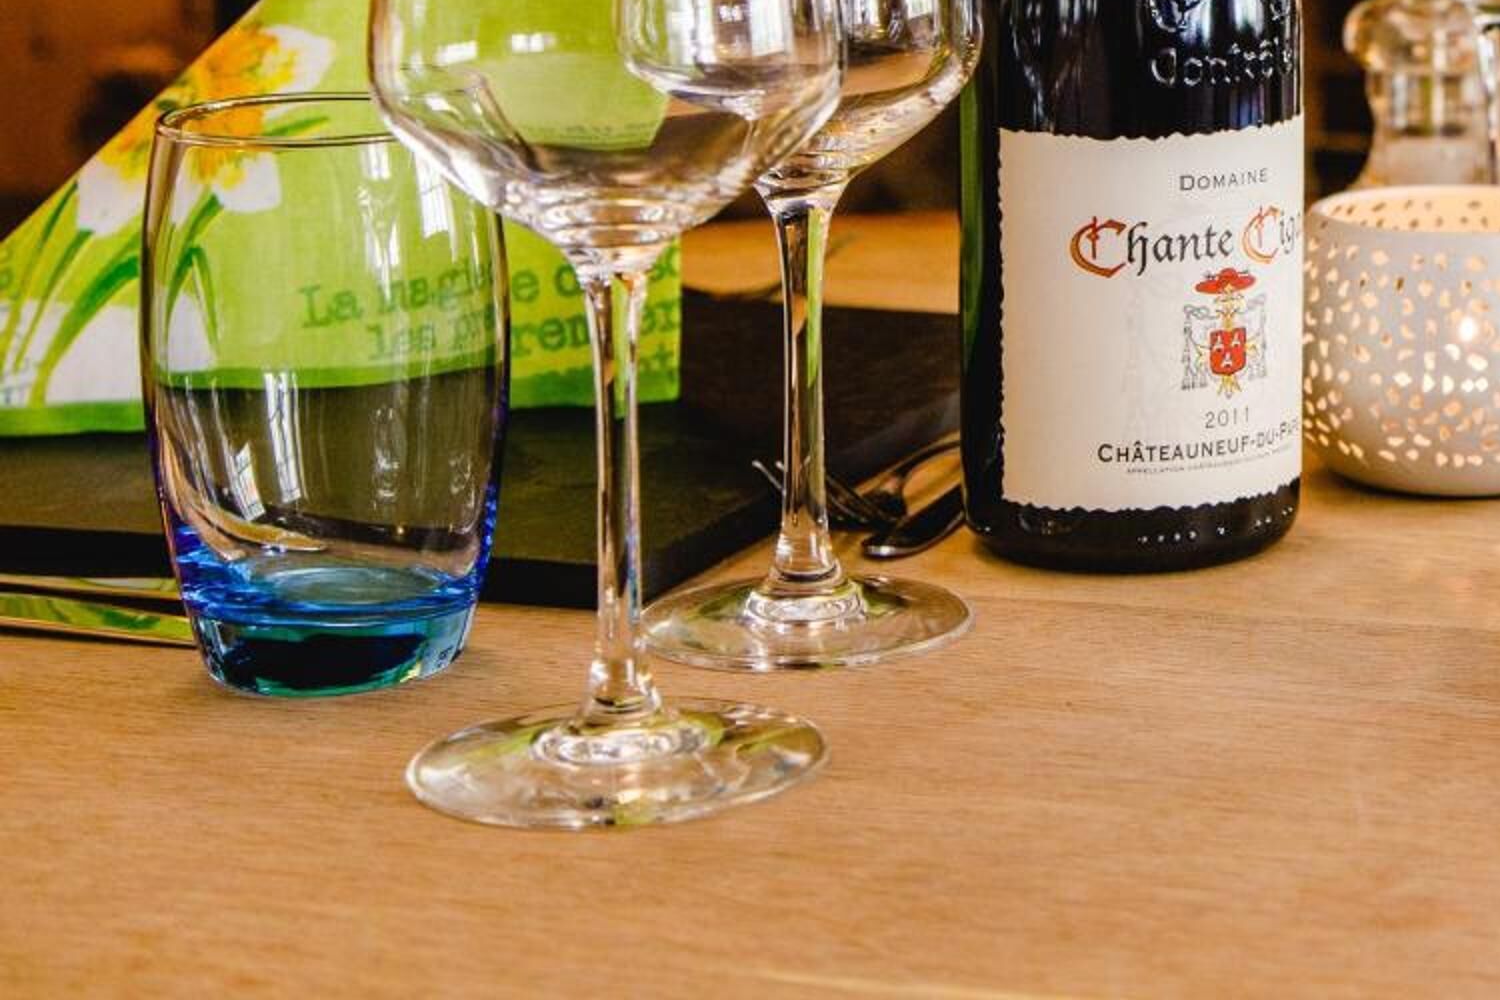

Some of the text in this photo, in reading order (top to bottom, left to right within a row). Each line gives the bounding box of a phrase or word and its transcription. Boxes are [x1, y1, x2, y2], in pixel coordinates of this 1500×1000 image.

[1070, 204, 1300, 278] Chante Cig
[1204, 406, 1249, 429] 2011
